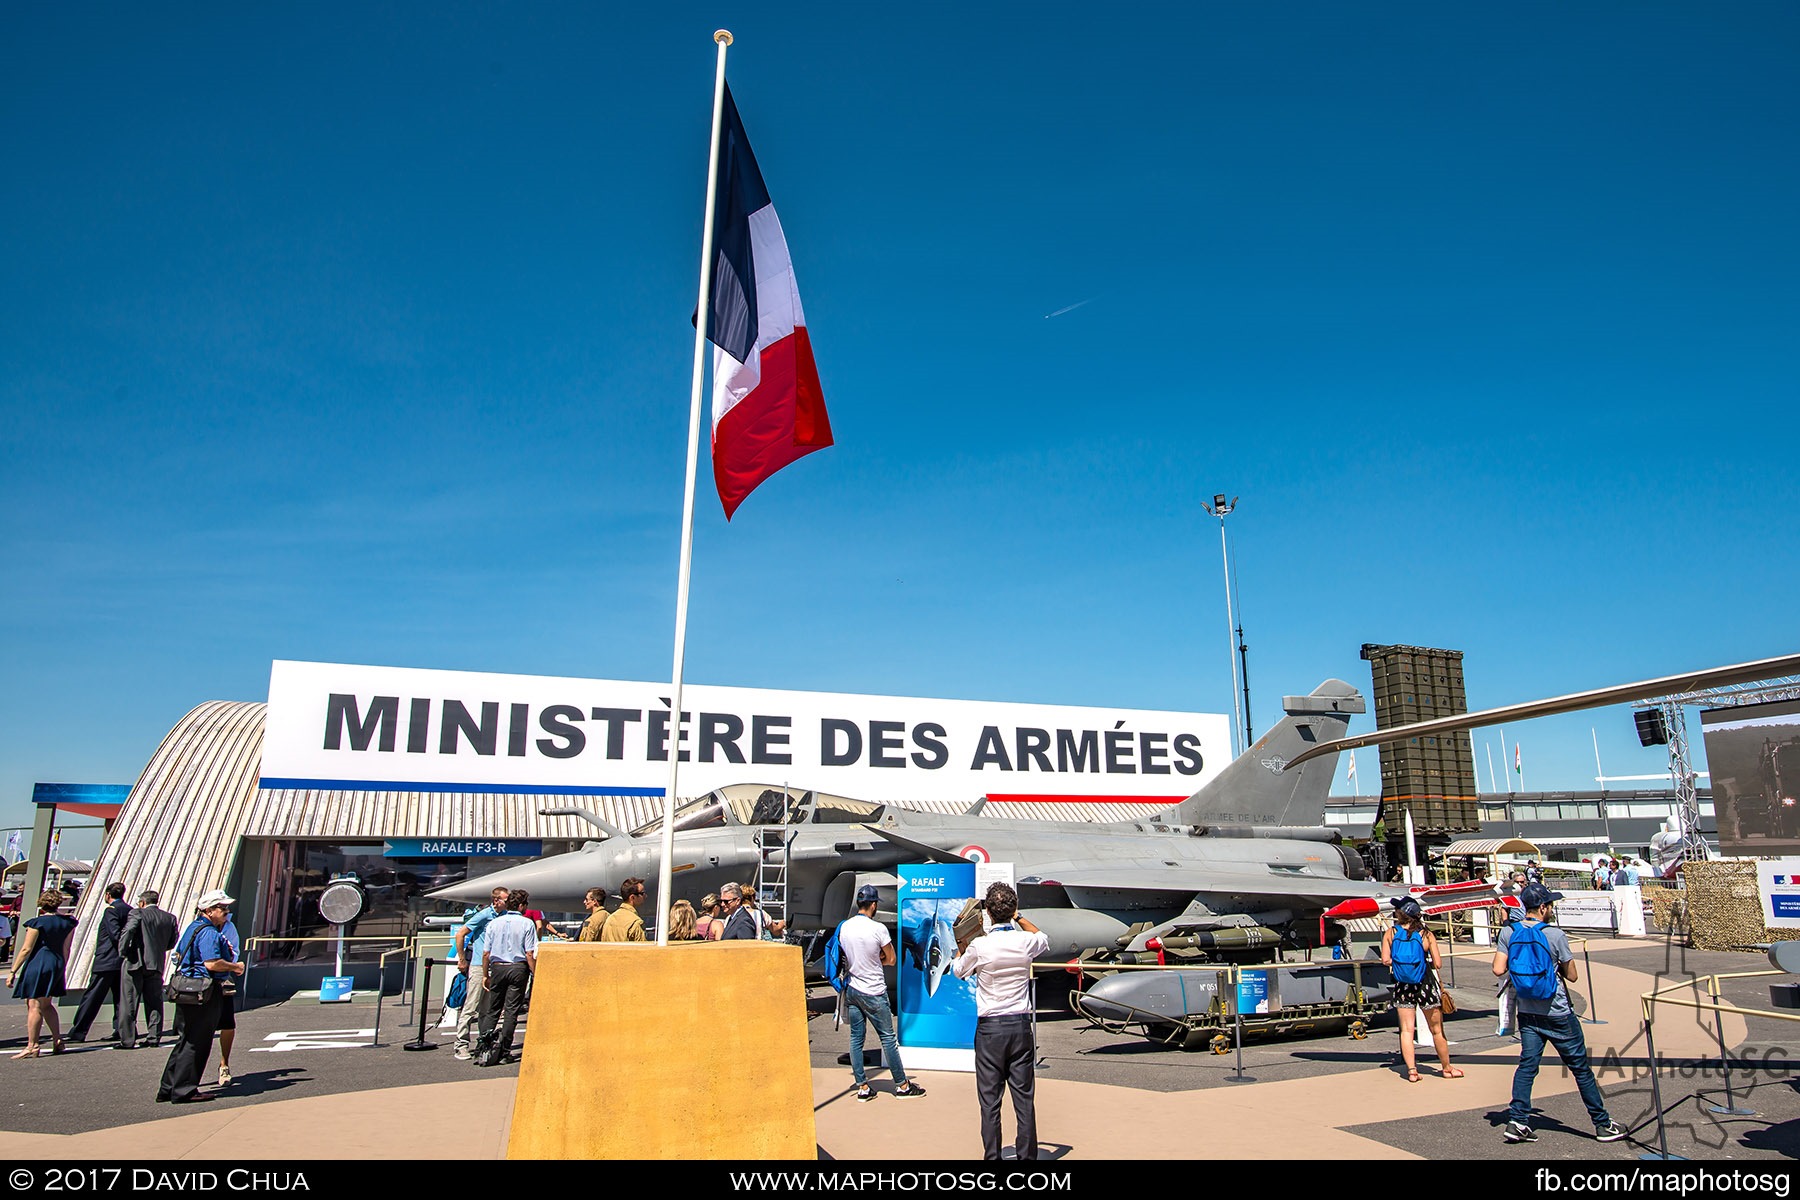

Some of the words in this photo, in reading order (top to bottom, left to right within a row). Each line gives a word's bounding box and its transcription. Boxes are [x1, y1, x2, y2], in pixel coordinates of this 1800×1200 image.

[323, 693, 792, 765] MINISTÈRE
[820, 717, 949, 770] DES
[970, 720, 1204, 776] ARMÉES
[1238, 813, 1249, 822] DE
[422, 842, 473, 853] RAFALE
[476, 842, 506, 853] F3-R
[911, 877, 945, 887] RAFALE
